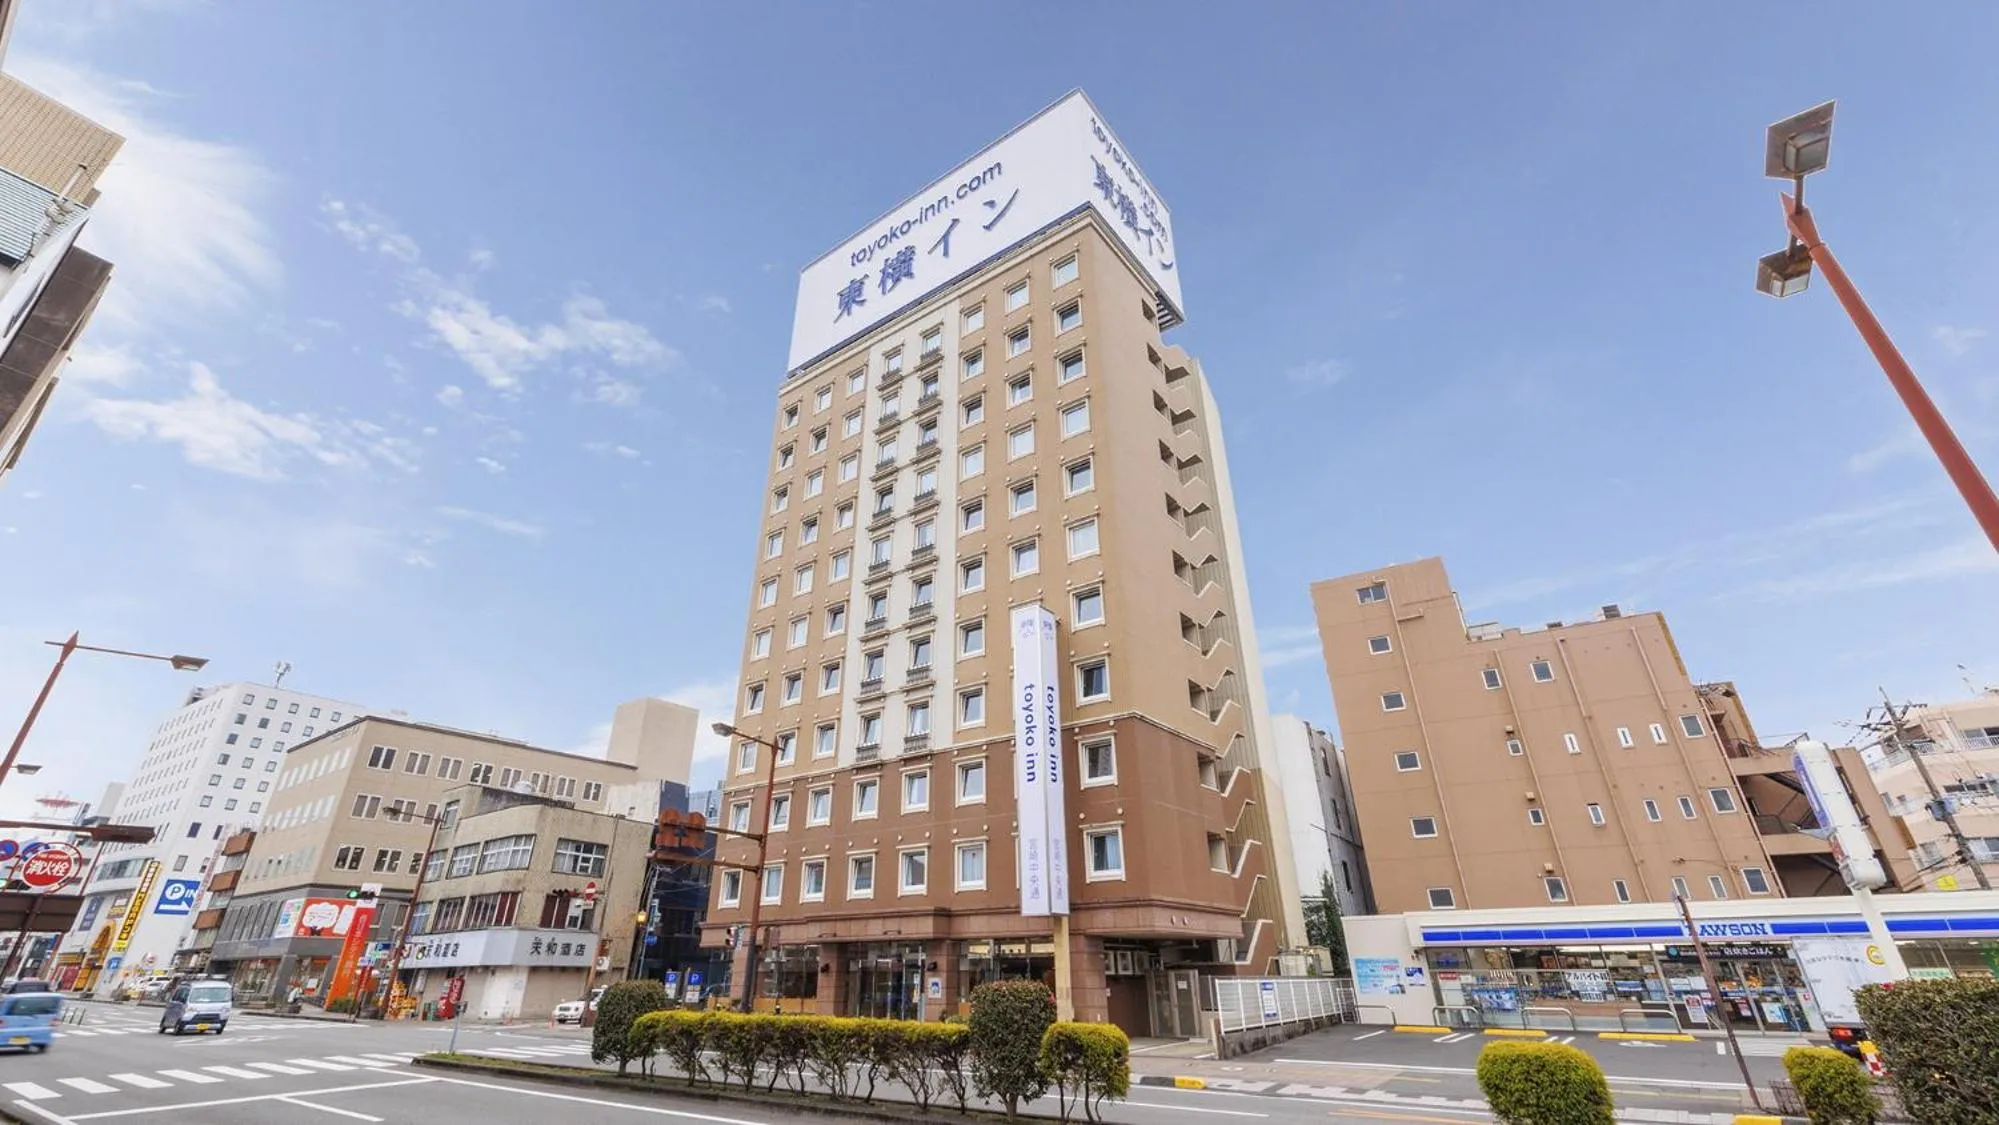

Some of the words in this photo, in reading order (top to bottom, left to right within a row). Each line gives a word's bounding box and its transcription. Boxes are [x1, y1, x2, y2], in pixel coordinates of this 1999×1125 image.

[850, 162, 1002, 267] toyoko-inn.com
[1090, 154, 1174, 270] 東横イン
[834, 188, 1020, 324] 東横イン
[1021, 683, 1038, 747] toyoko
[1046, 685, 1060, 748] toyoko
[1025, 753, 1039, 783] inn
[1050, 754, 1060, 783] inn
[26, 859, 70, 877] 消火栓
[170, 886, 182, 897] P
[1684, 923, 1769, 937] AWSON
